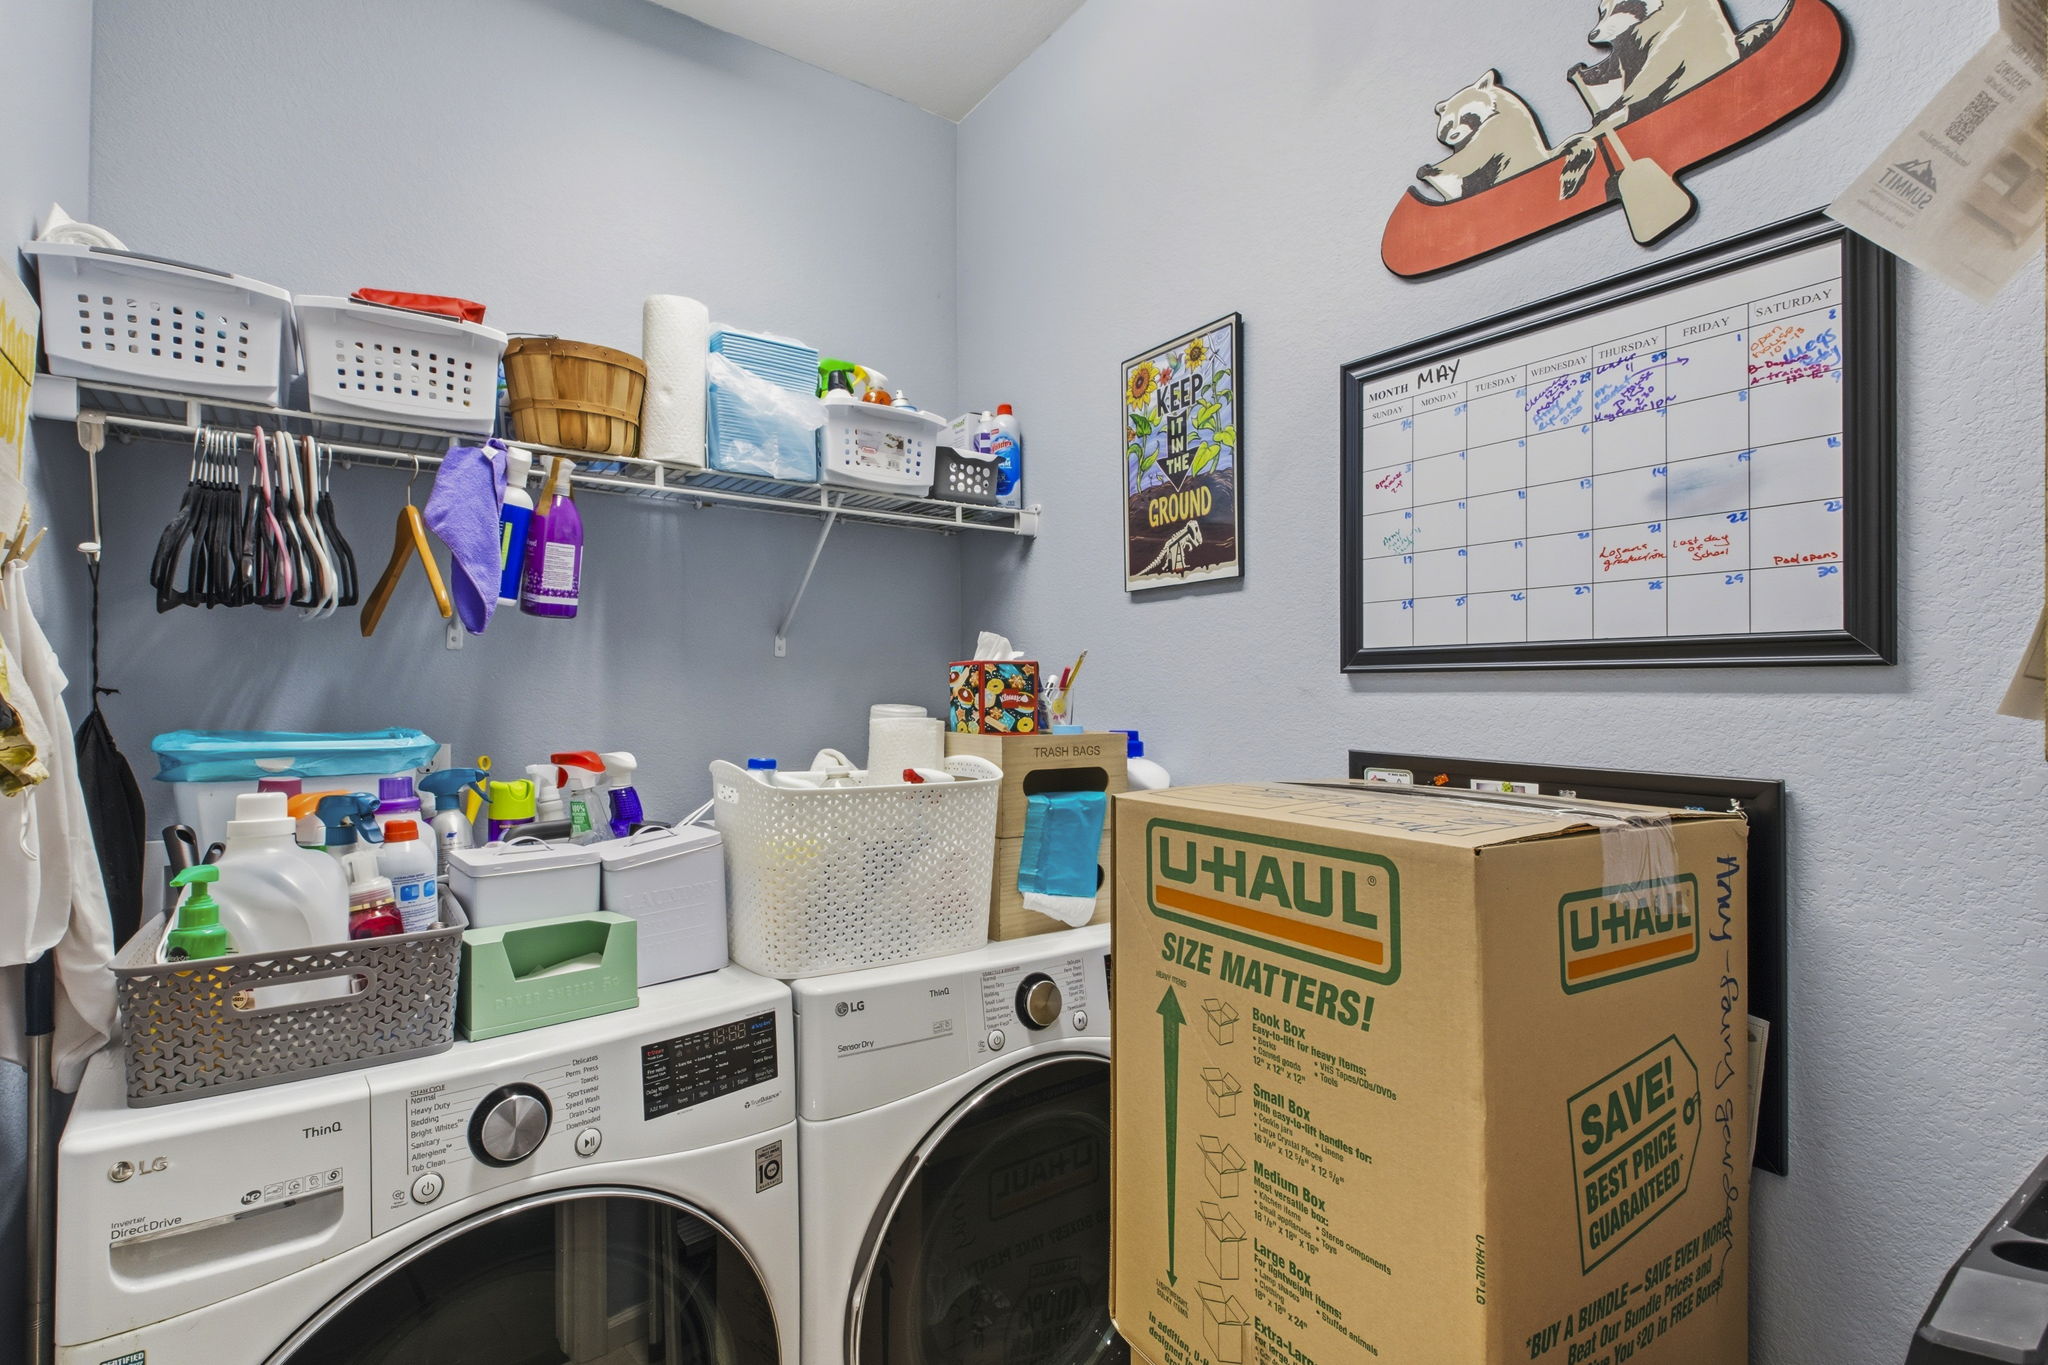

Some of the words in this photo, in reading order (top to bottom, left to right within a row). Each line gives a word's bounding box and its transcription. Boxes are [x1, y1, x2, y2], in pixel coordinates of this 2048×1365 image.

[1756, 289, 1832, 317] SATURDAY
[1828, 308, 1837, 320] 2
[1683, 316, 1730, 337] FRIDAY
[1599, 336, 1659, 359] THURSDAY
[1736, 334, 1742, 342] 1
[1531, 355, 1588, 377] WEDNESDAY
[1830, 370, 1841, 383] 9
[1368, 384, 1409, 402] MONTH
[1417, 359, 1460, 389] MAY
[1475, 375, 1518, 393] TUESDAY
[1156, 373, 1204, 417] KEEP
[1421, 391, 1458, 407] MONDAY
[1372, 406, 1404, 420] SUNDAY
[1170, 416, 1184, 437] IT
[1171, 435, 1184, 453] IN
[1166, 453, 1190, 476] THE
[1580, 478, 1592, 489] 13
[1148, 485, 1212, 528] GROUND
[1824, 500, 1842, 513] 23
[1726, 511, 1749, 524] 22
[1725, 574, 1744, 586] 29
[1817, 565, 1839, 577] 30
[1574, 586, 1591, 595] 27
[1033, 746, 1070, 759] TRASH
[1072, 745, 1101, 758] BAGS
[1159, 836, 1378, 930] U-HAUL
[1570, 891, 1692, 952] U-HAUL
[929, 987, 950, 998] ThinQ
[1161, 932, 1214, 976] SIZE
[1219, 950, 1376, 1032] MATTERS!
[850, 1000, 865, 1013] LG
[1252, 1007, 1281, 1030] Book
[1284, 1018, 1306, 1040] Box
[572, 1054, 599, 1066] Delicates
[1252, 1023, 1295, 1049] Easy-to-lift
[1297, 1041, 1309, 1053] for
[1311, 1046, 1336, 1066] heavy
[1338, 1056, 1367, 1077] items:
[583, 1064, 599, 1073] Press
[1320, 1061, 1334, 1075] VHS
[410, 1093, 436, 1105] Normal
[565, 1100, 584, 1110] Speed
[585, 1095, 600, 1104] Wash
[567, 1085, 599, 1099] Sportswear
[1253, 1083, 1285, 1109] Small
[1288, 1098, 1311, 1122] Box
[410, 1106, 433, 1117] Heavy
[434, 1101, 451, 1112] Duty
[1581, 1055, 1675, 1155] SAVE!
[302, 1121, 343, 1140] ThinQ
[410, 1115, 439, 1128] Bedding
[566, 1115, 601, 1131] Downloaded
[1253, 1098, 1271, 1114] With
[1272, 1109, 1317, 1138] easy-to-lift
[1319, 1129, 1354, 1156] handles
[1355, 1147, 1373, 1165] for:
[410, 1128, 433, 1139] Bright
[410, 1138, 441, 1150] Sanitary
[1277, 1133, 1300, 1151] Crystal
[138, 1156, 168, 1177] LG
[412, 1164, 424, 1173] Tub
[426, 1159, 446, 1169] Clean
[759, 1159, 780, 1184] 10
[1585, 1157, 1629, 1215] BEST
[1632, 1122, 1677, 1180] PRICE
[1253, 1159, 1299, 1197] Medium
[1302, 1186, 1326, 1212] Box
[1253, 1176, 1273, 1195] Most
[1274, 1189, 1309, 1215] versatile
[1311, 1210, 1329, 1227] box:
[1259, 1191, 1282, 1212] Kitchen
[1589, 1158, 1681, 1250] GUARANTEED
[111, 1216, 146, 1230] Inverter
[1254, 1237, 1286, 1269] Large
[1288, 1260, 1312, 1287] Box
[1254, 1253, 1266, 1269] For
[1268, 1261, 1313, 1301] lightweight
[1315, 1293, 1342, 1321] items:
[1563, 1314, 1574, 1341] A
[1674, 1236, 1700, 1272] EVEN
[1568, 1331, 1597, 1365] Beat
[1600, 1321, 1621, 1348] Our
[1624, 1297, 1661, 1333] Bundle
[1664, 1275, 1694, 1306] Prices
[1696, 1254, 1713, 1283] and
[1149, 1311, 1157, 1324] In
[1158, 1320, 1191, 1356] addition,
[1614, 1339, 1634, 1365] You
[1636, 1327, 1654, 1351] $20
[1657, 1316, 1668, 1339] in
[1670, 1297, 1694, 1329] FREE
[1149, 1326, 1184, 1362] designed
[1349, 1331, 1379, 1357] animals
